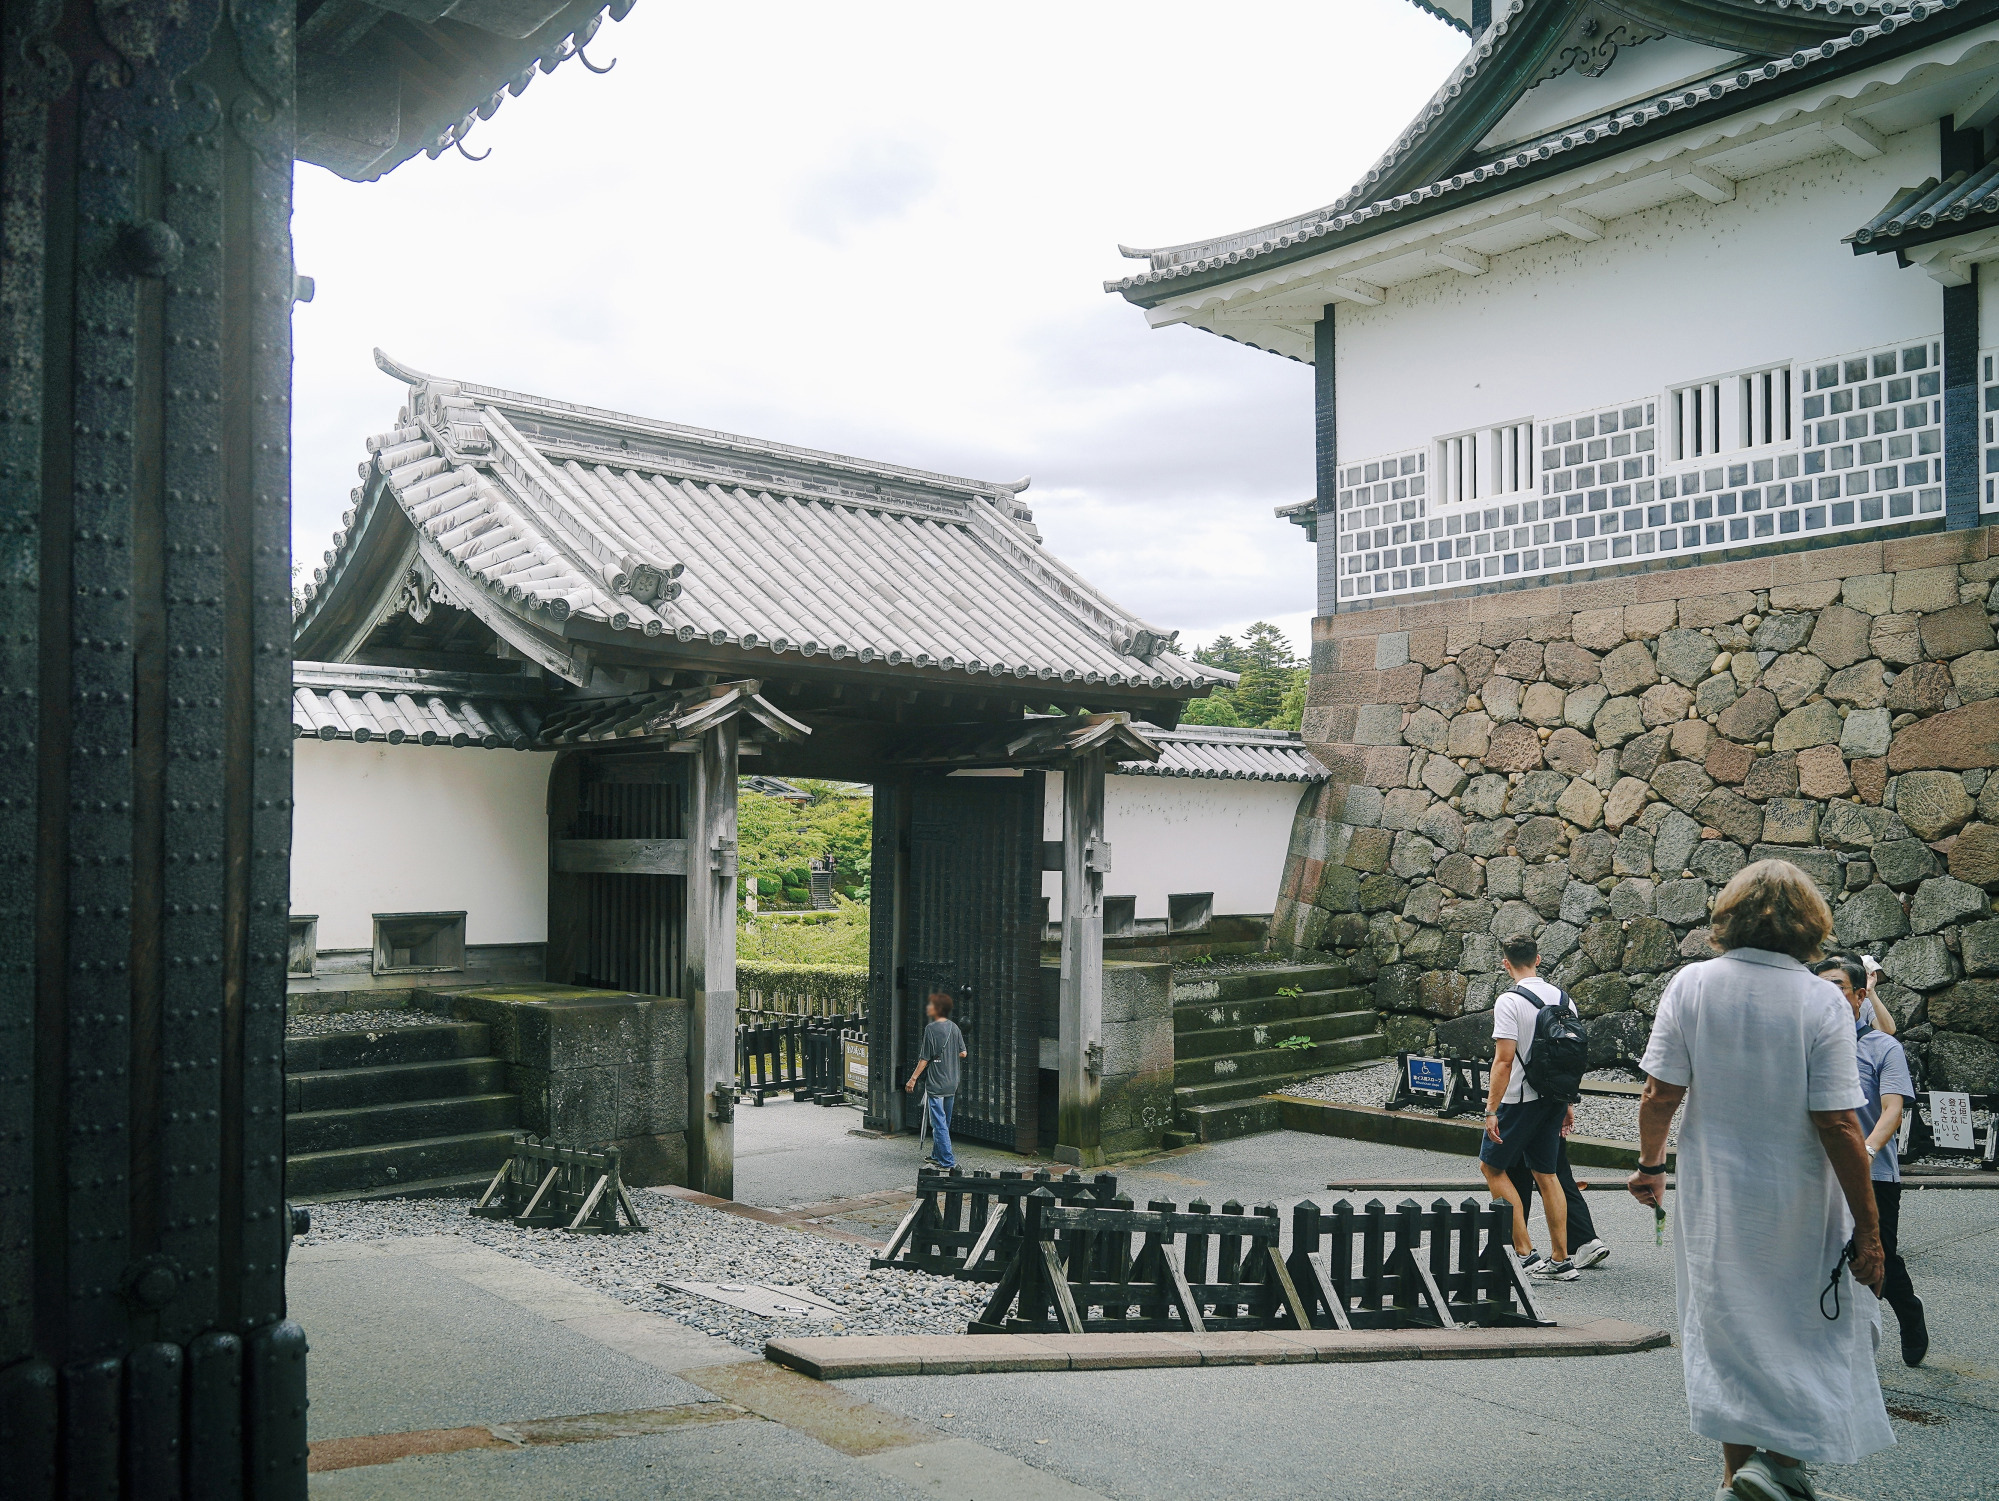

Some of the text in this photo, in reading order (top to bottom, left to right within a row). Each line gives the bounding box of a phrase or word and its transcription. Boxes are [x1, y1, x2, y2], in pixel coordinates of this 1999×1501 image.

[1940, 1098, 1949, 1136] ください。
[1948, 1098, 1960, 1141] 登らないで
[1958, 1099, 1968, 1124] 石垣に
